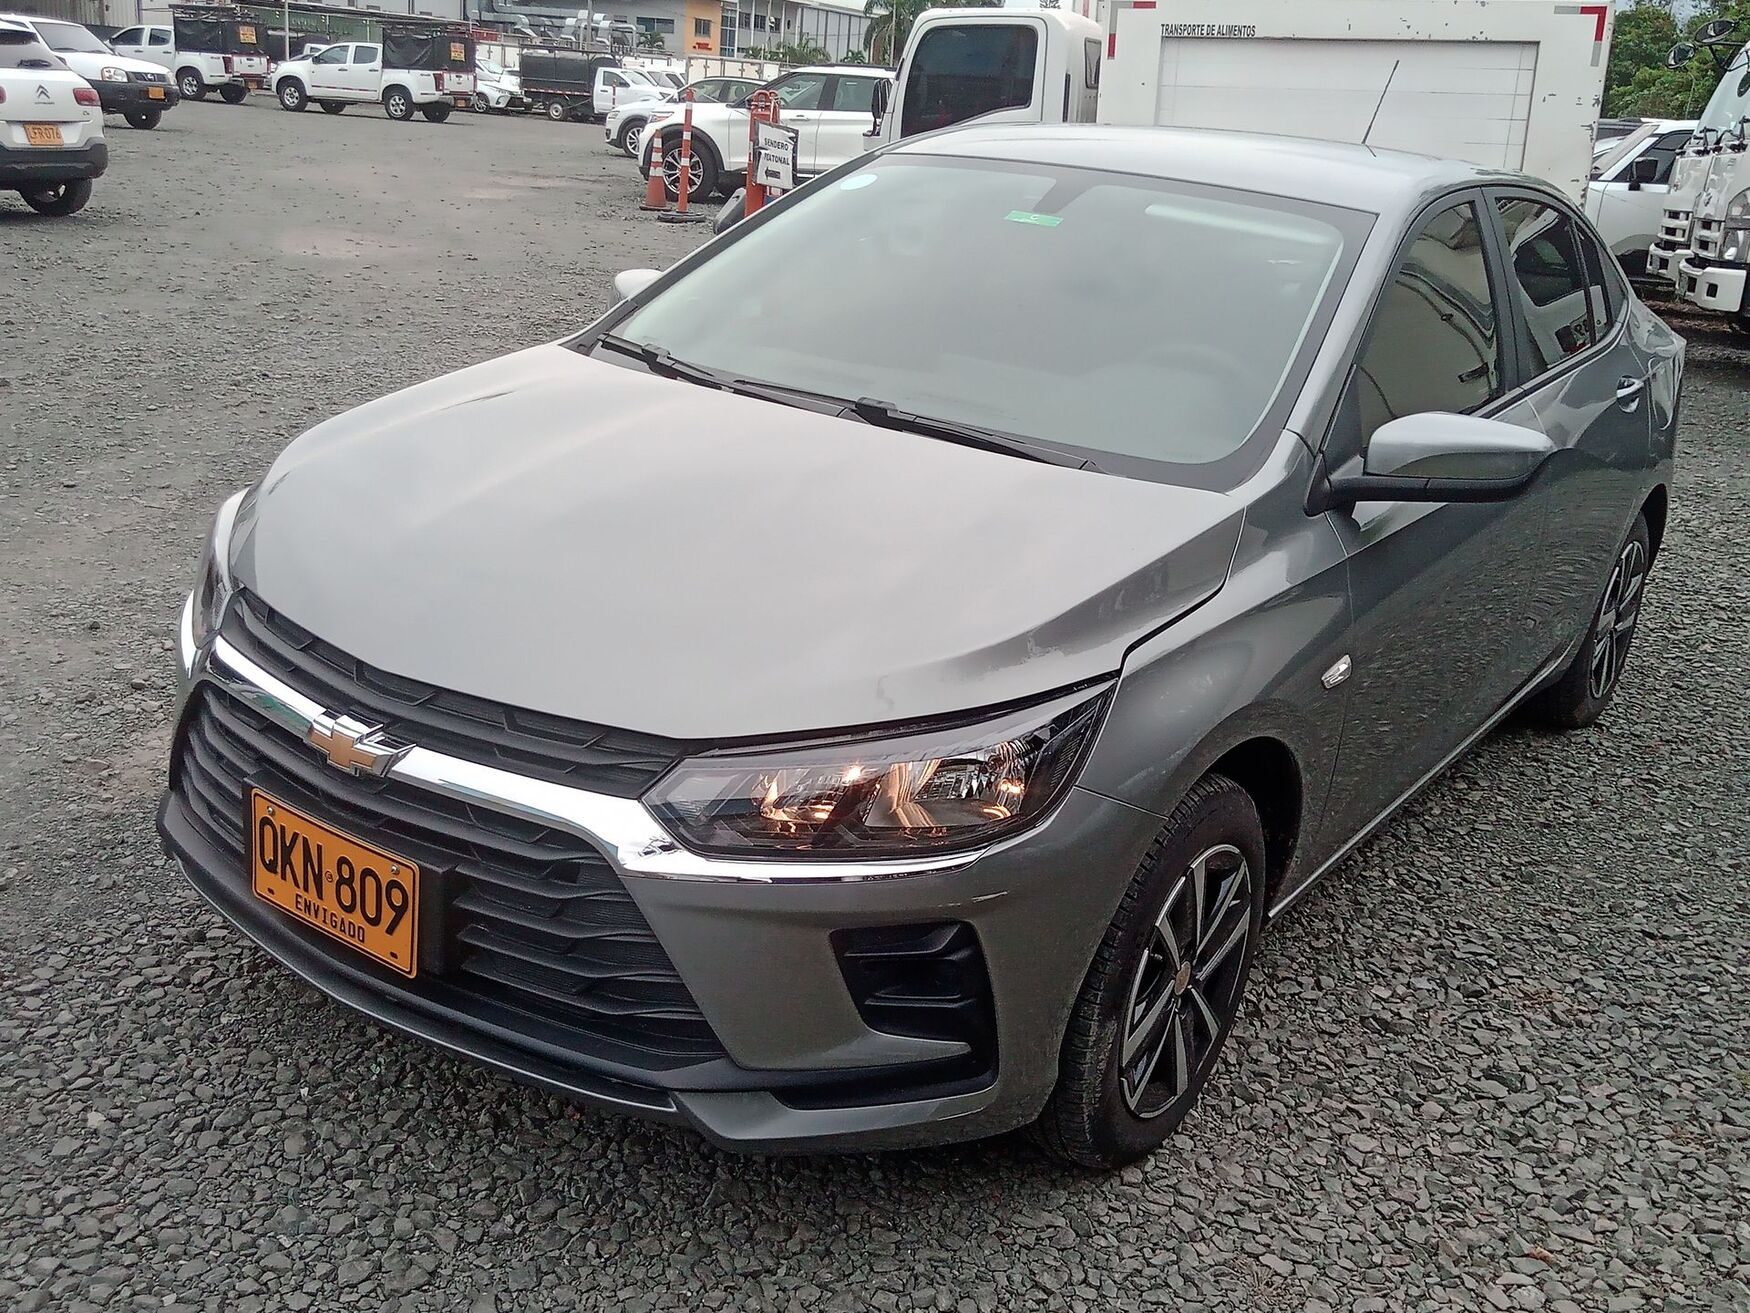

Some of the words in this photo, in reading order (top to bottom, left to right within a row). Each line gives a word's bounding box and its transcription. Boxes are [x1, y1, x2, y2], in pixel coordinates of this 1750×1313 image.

[1161, 24, 1205, 36] TRANSPORTE
[1206, 24, 1216, 36] DE
[1217, 24, 1256, 37] ALIMENTOS
[764, 137, 789, 151] SENDERO
[259, 816, 324, 901] QKN
[335, 855, 410, 936] 809
[295, 892, 366, 944] ENVIGADO
